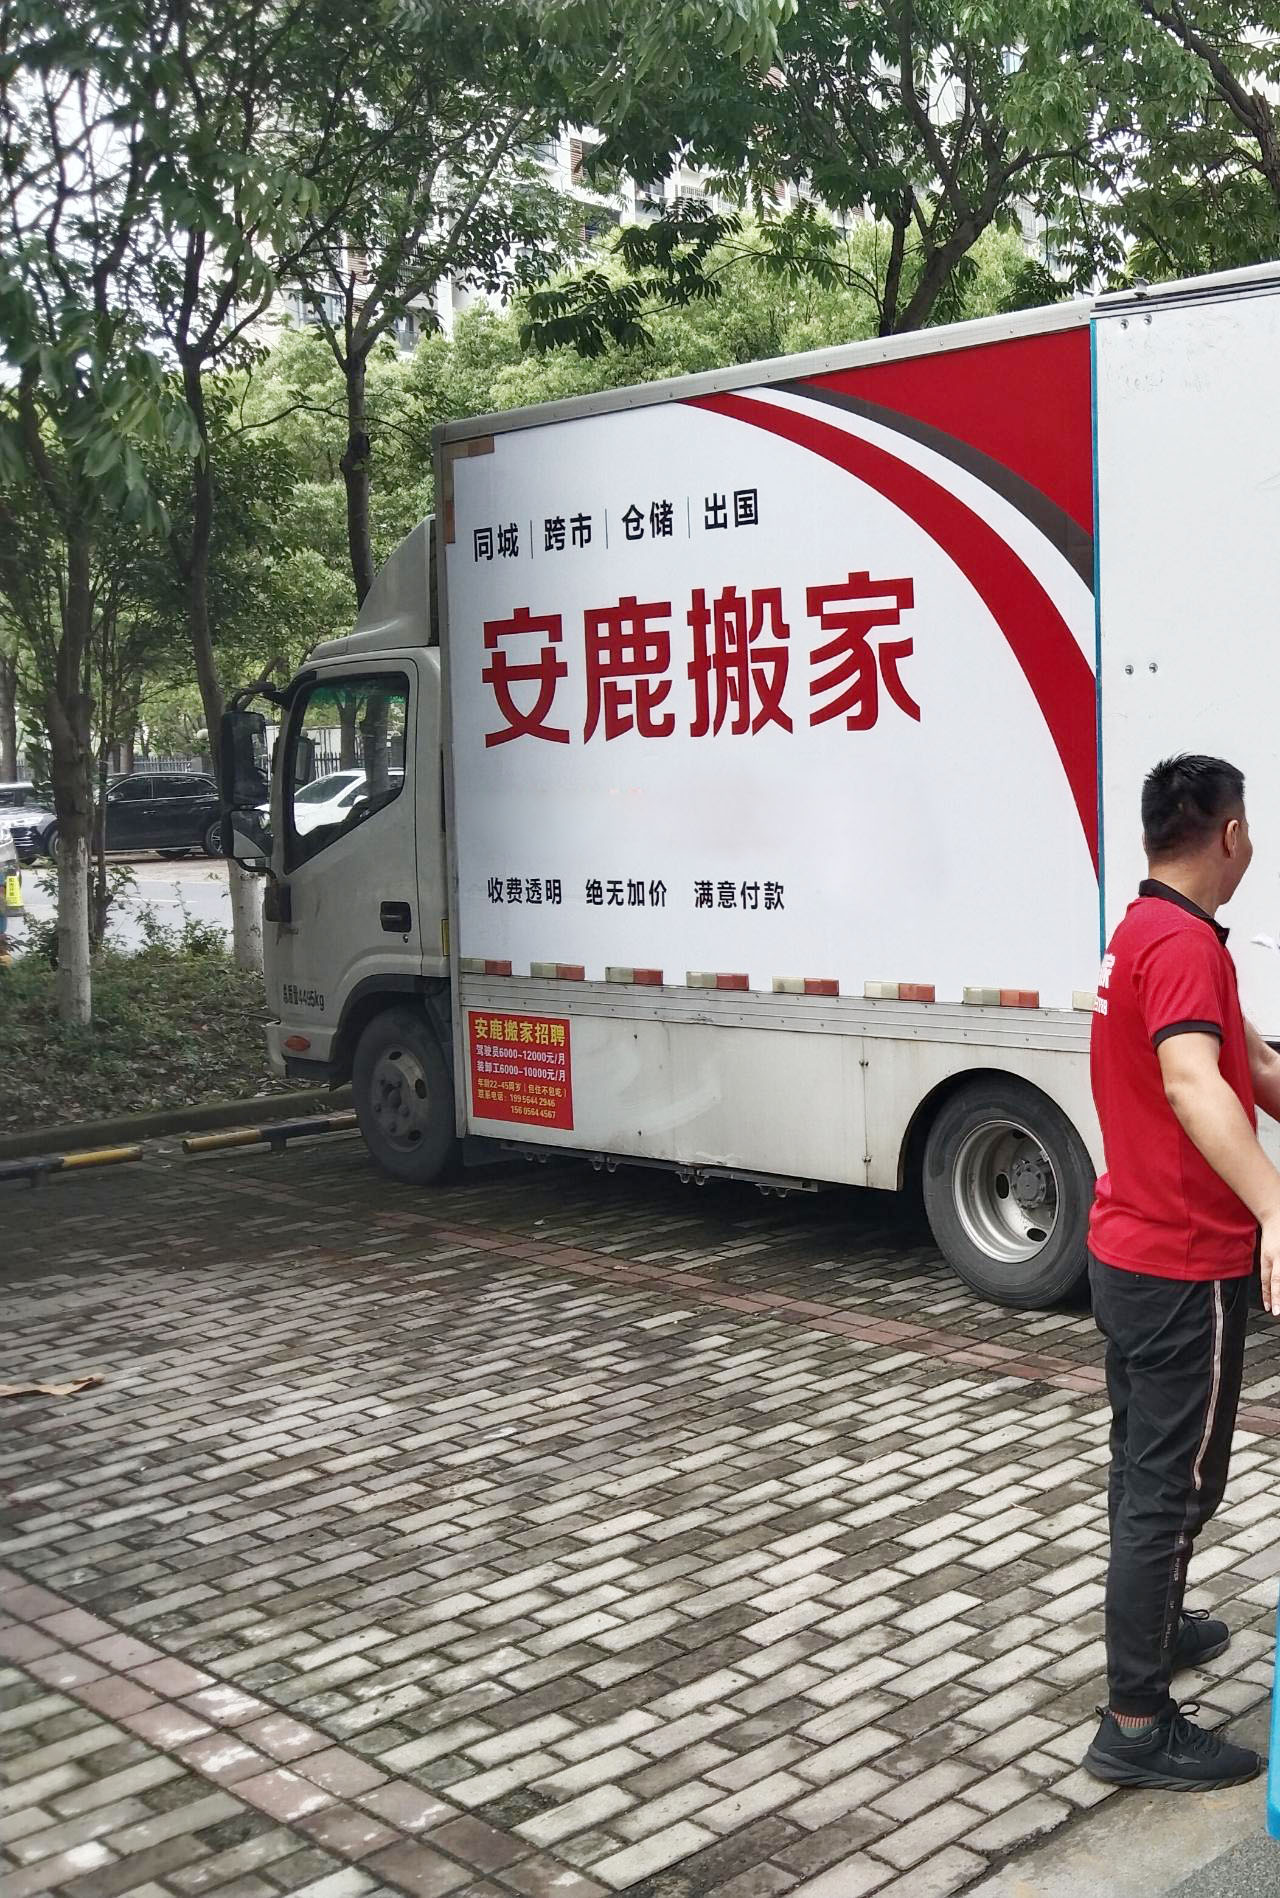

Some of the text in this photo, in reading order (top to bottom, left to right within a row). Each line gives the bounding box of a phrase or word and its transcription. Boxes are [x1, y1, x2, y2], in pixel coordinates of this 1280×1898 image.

[473, 488, 759, 562] 同城 跨市 仓储 出国
[481, 570, 921, 749] 安鹿搬家
[487, 877, 786, 911] 收费透明 绝无加价 满意付款
[474, 1017, 566, 1047] 安鹿搬家招聘
